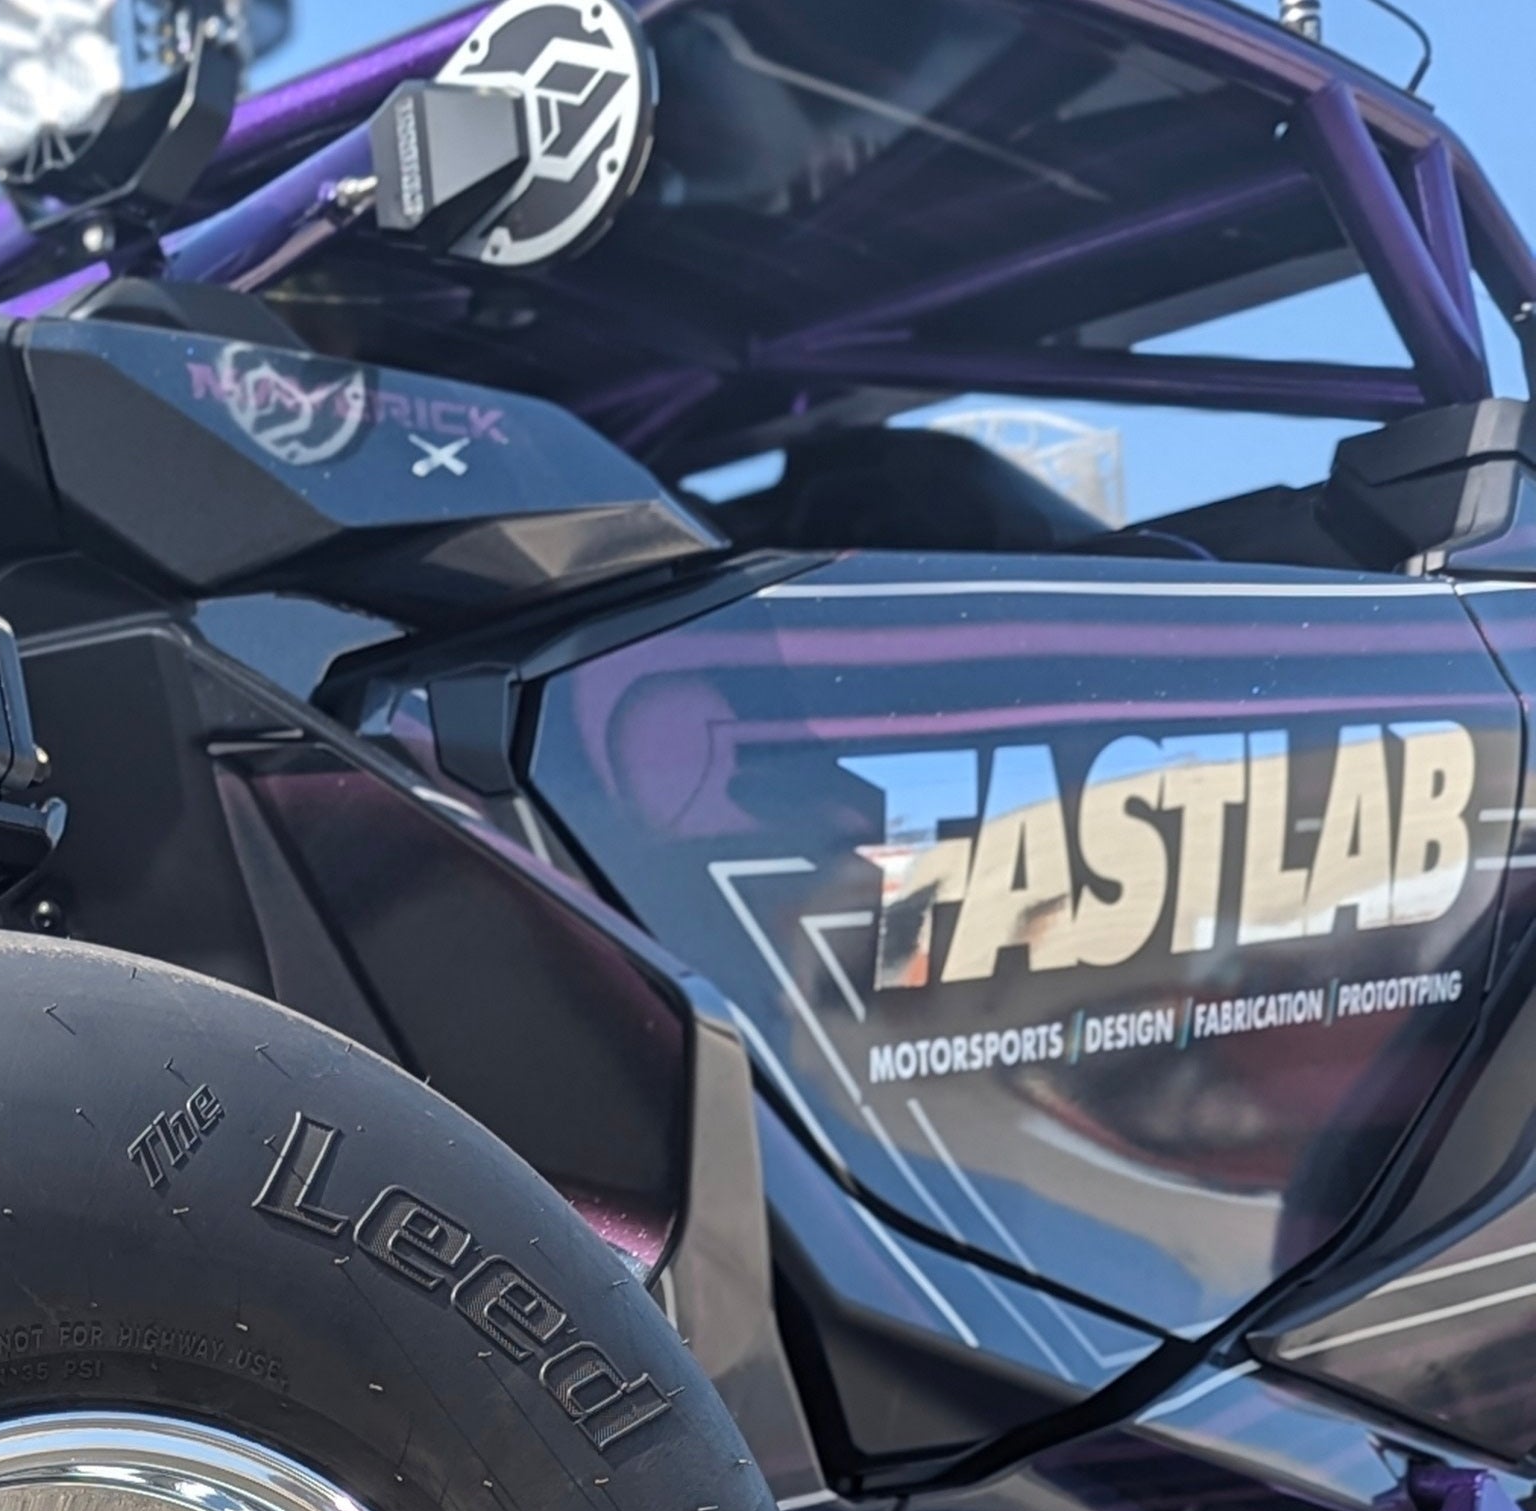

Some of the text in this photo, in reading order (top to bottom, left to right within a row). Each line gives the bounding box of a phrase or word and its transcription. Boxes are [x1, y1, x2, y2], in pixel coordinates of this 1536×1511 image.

[837, 721, 1475, 991] FASTLAB
[869, 970, 1463, 1084] MOTORSPORTS DESIGN FABRICATION PROTOTYPING
[126, 1083, 226, 1189] The
[251, 1110, 673, 1453] Leed
[19, 1358, 50, 1383] 35
[62, 1356, 104, 1380] PSI
[57, 1319, 105, 1349] FOR
[116, 1321, 227, 1364] HIGHWAY
